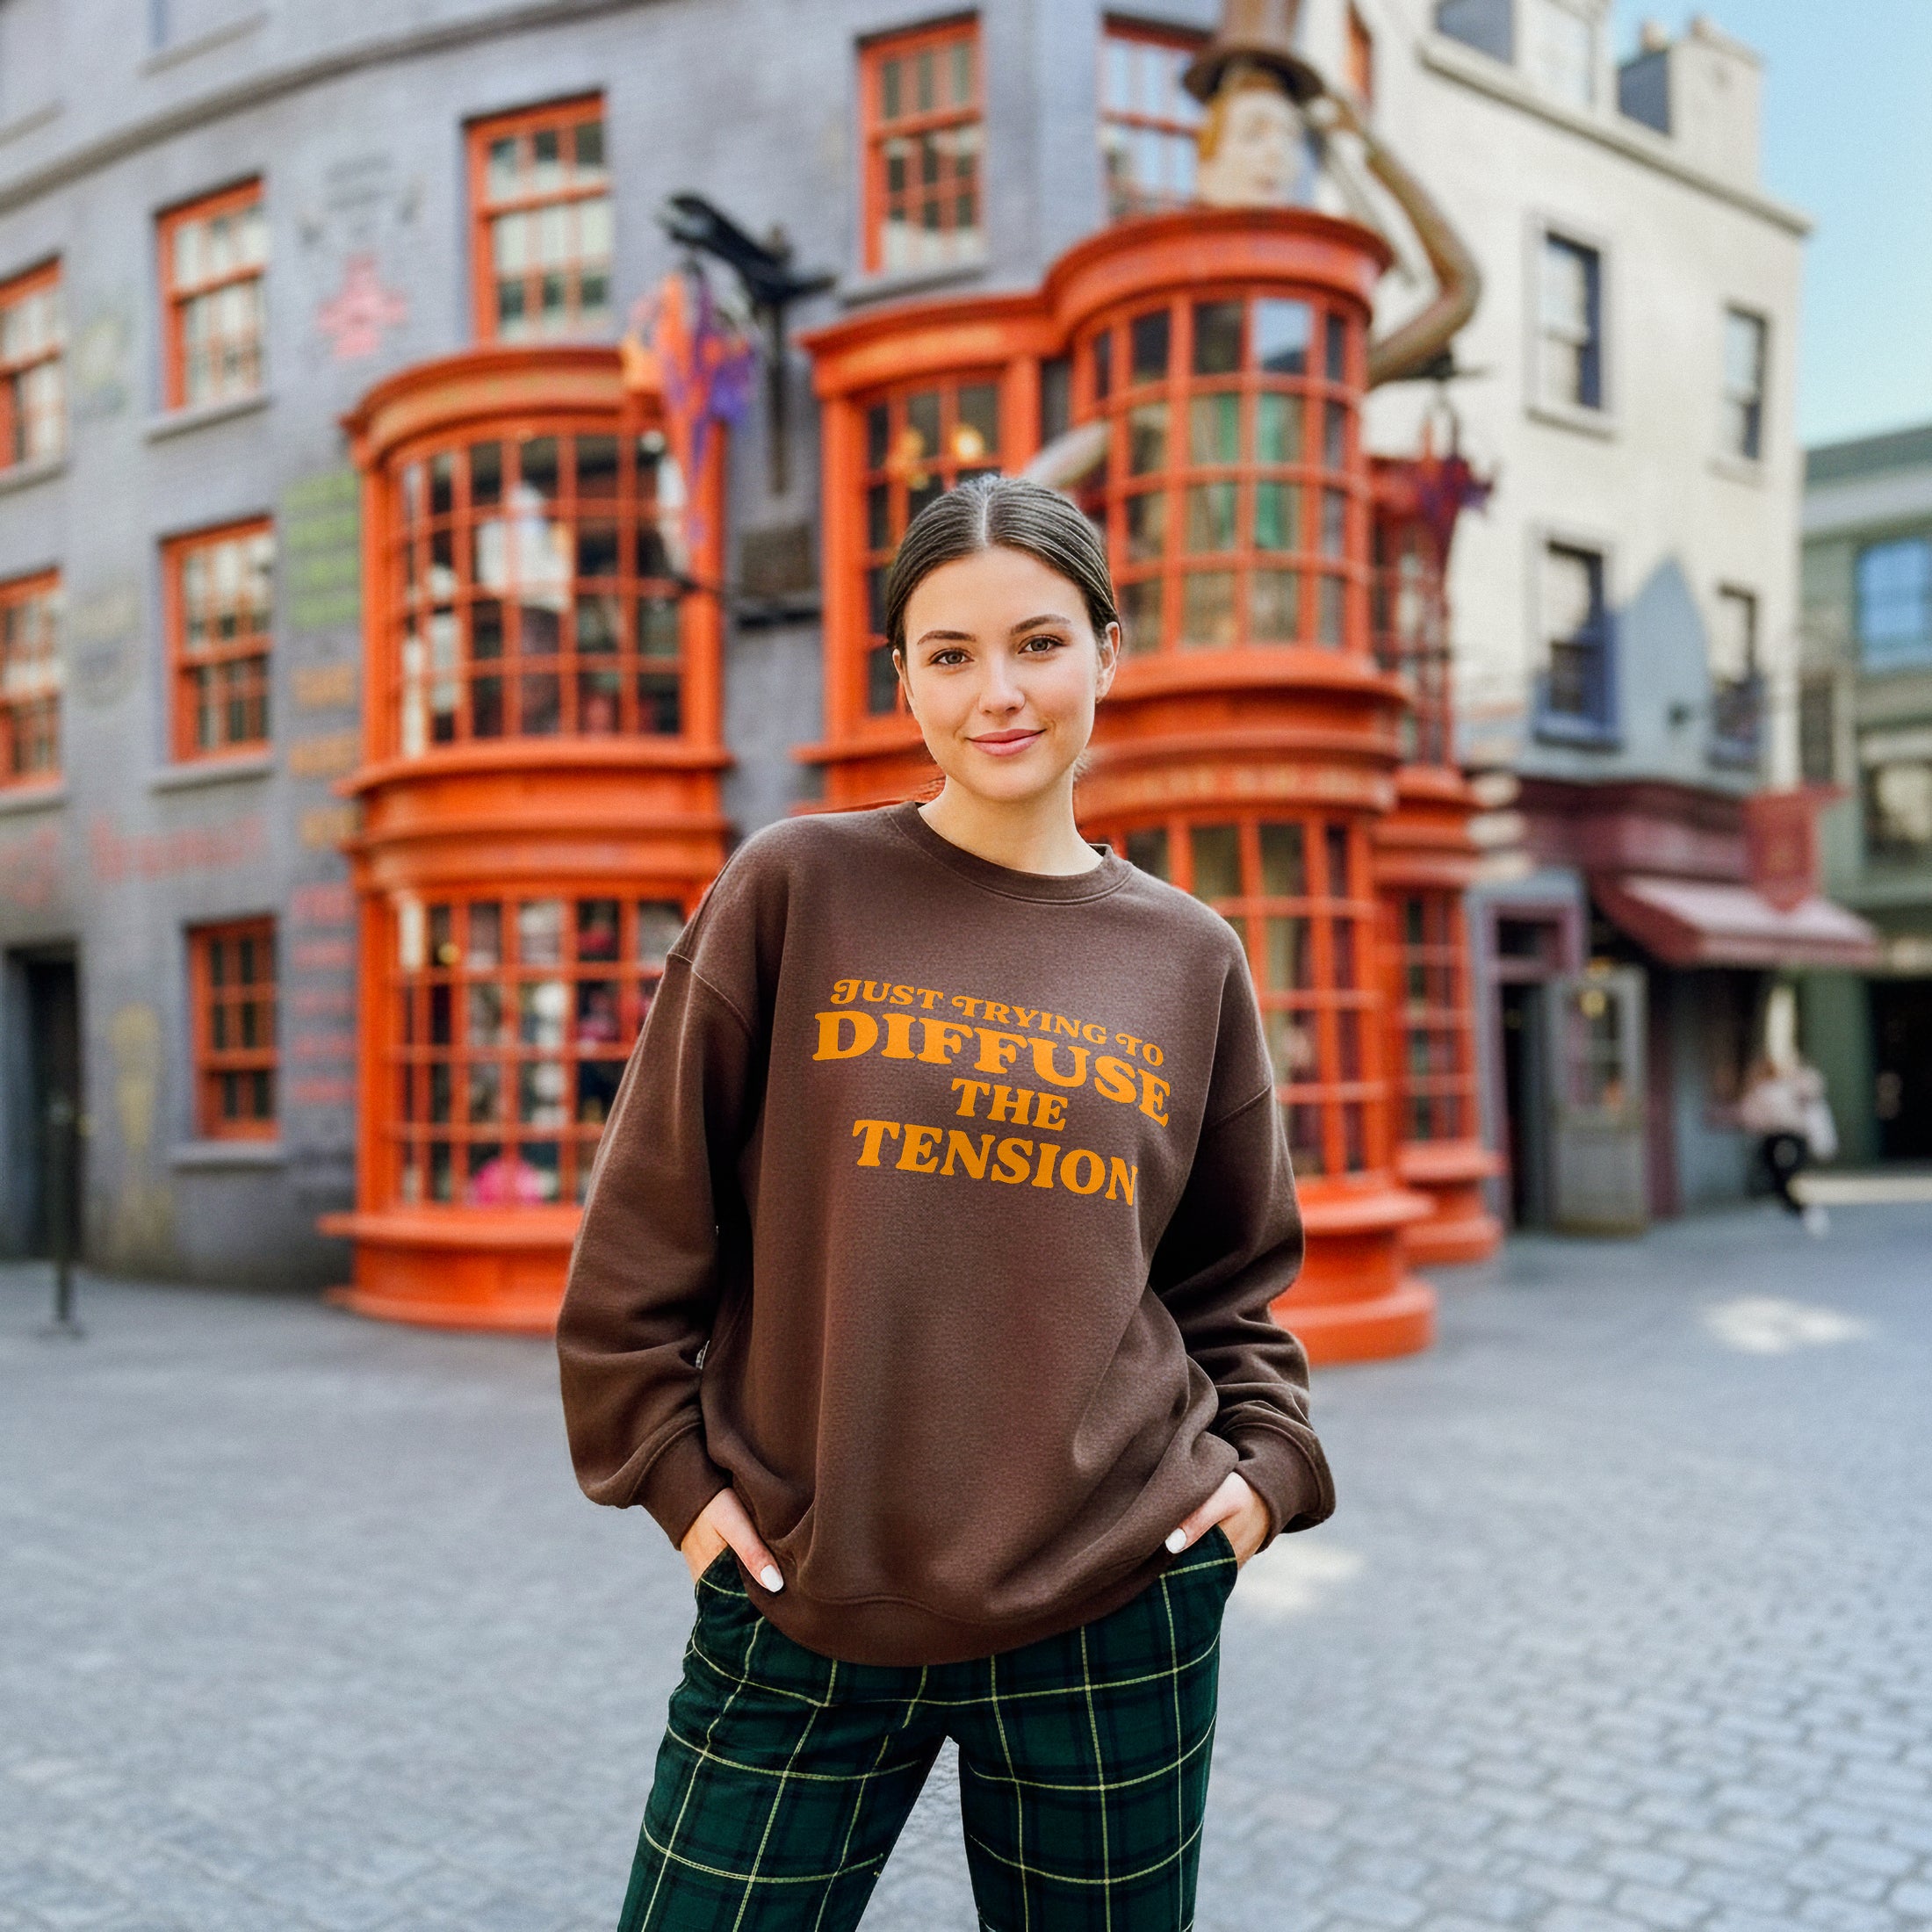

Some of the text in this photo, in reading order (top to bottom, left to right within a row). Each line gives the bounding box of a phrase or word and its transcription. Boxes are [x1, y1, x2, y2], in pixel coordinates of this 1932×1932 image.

[830, 979, 1164, 1067] JUST TRYING TO
[812, 1010, 1171, 1128] DIFFUSE
[951, 1078, 1069, 1131] THE
[852, 1119, 1138, 1207] TENSION
